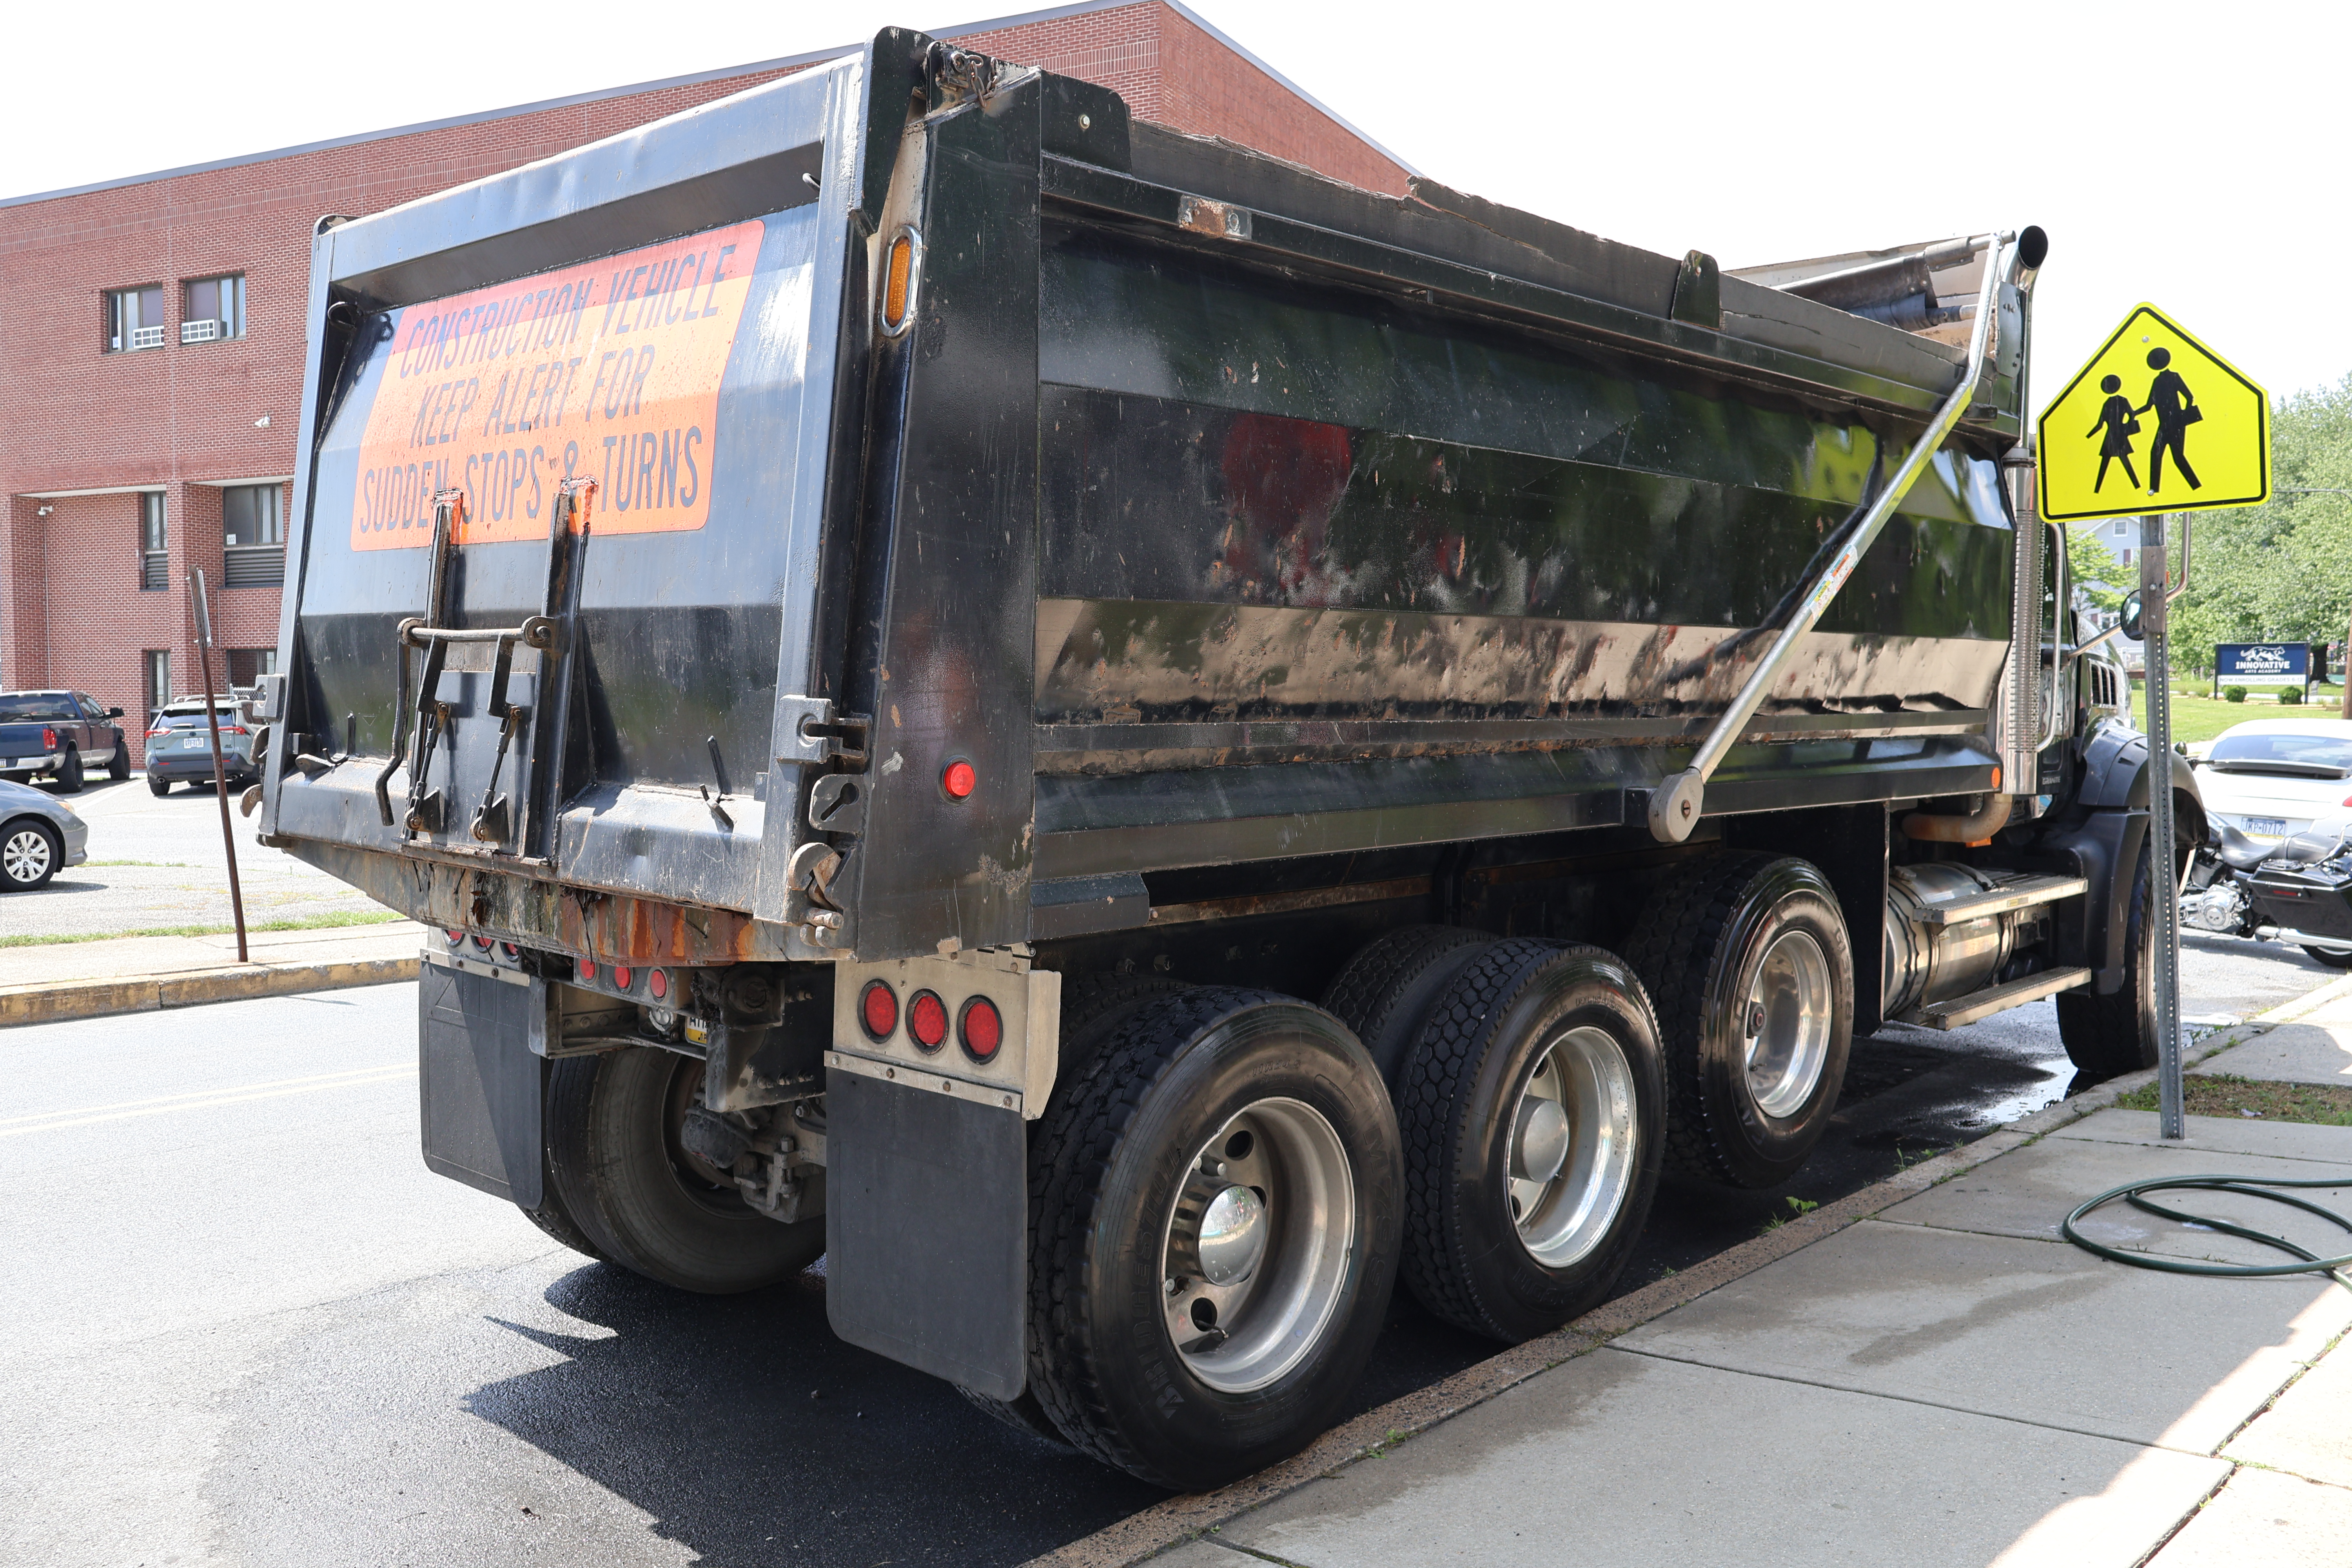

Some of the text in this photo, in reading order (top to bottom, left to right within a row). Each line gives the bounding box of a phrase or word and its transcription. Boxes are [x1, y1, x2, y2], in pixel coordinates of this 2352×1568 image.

[400, 244, 736, 378] CONSTRUCTION VEHICLE
[409, 343, 655, 449] KEEP ALERT FOR
[463, 447, 545, 524] STOPS
[601, 425, 702, 513] TURNS
[2235, 661, 2290, 669] INNOVATIVE
[1131, 1113, 1194, 1419] BRIDGESTONE
[1363, 1127, 1392, 1298] M799
